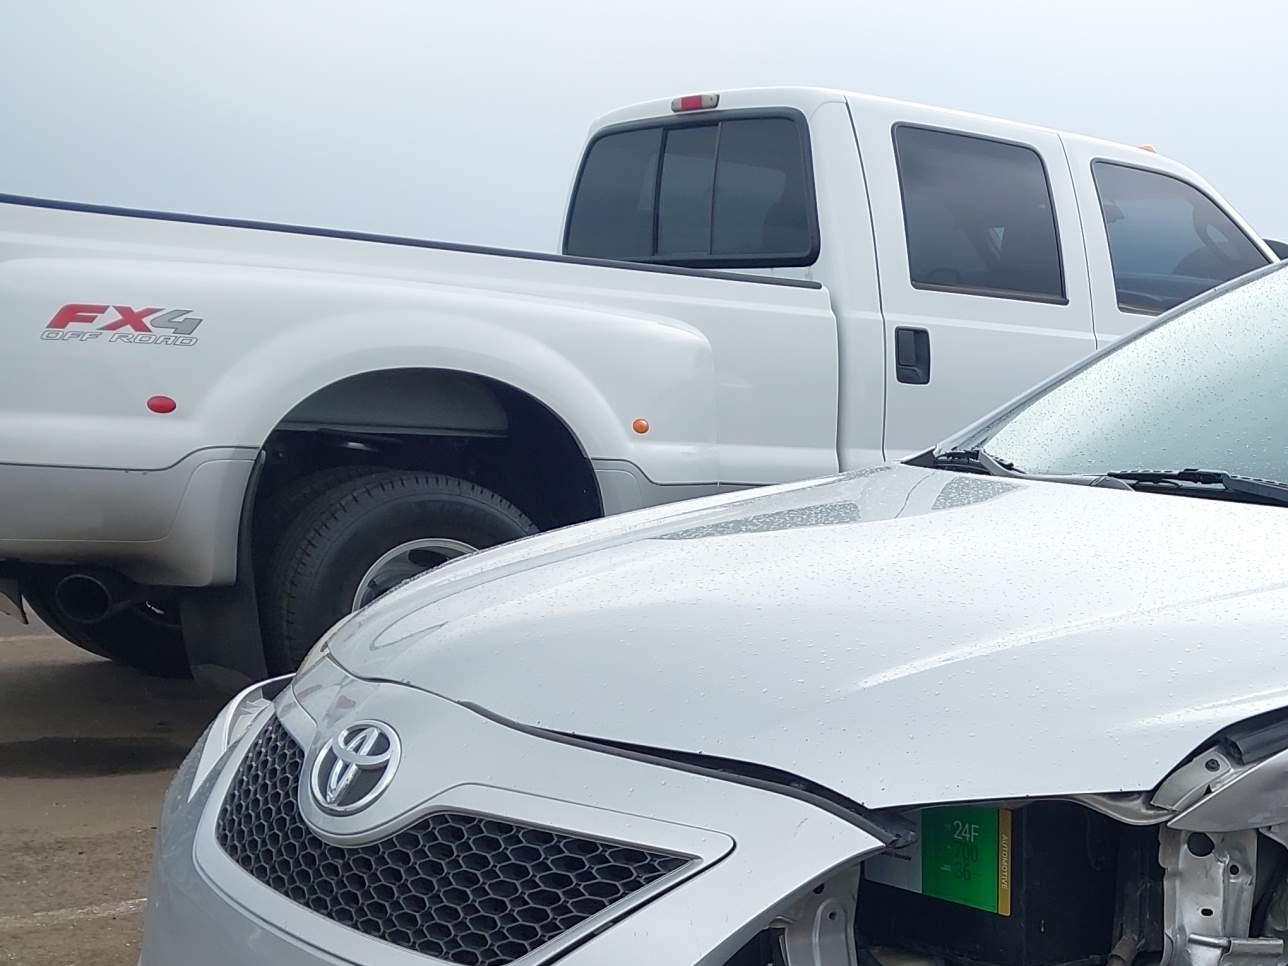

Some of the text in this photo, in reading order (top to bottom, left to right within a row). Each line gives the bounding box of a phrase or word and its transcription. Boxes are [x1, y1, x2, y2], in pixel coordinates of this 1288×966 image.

[45, 303, 204, 335] FX4
[41, 330, 199, 347] OFF ROAD
[952, 819, 980, 843] 24F
[1000, 834, 1009, 889] AUTOMOTIVE
